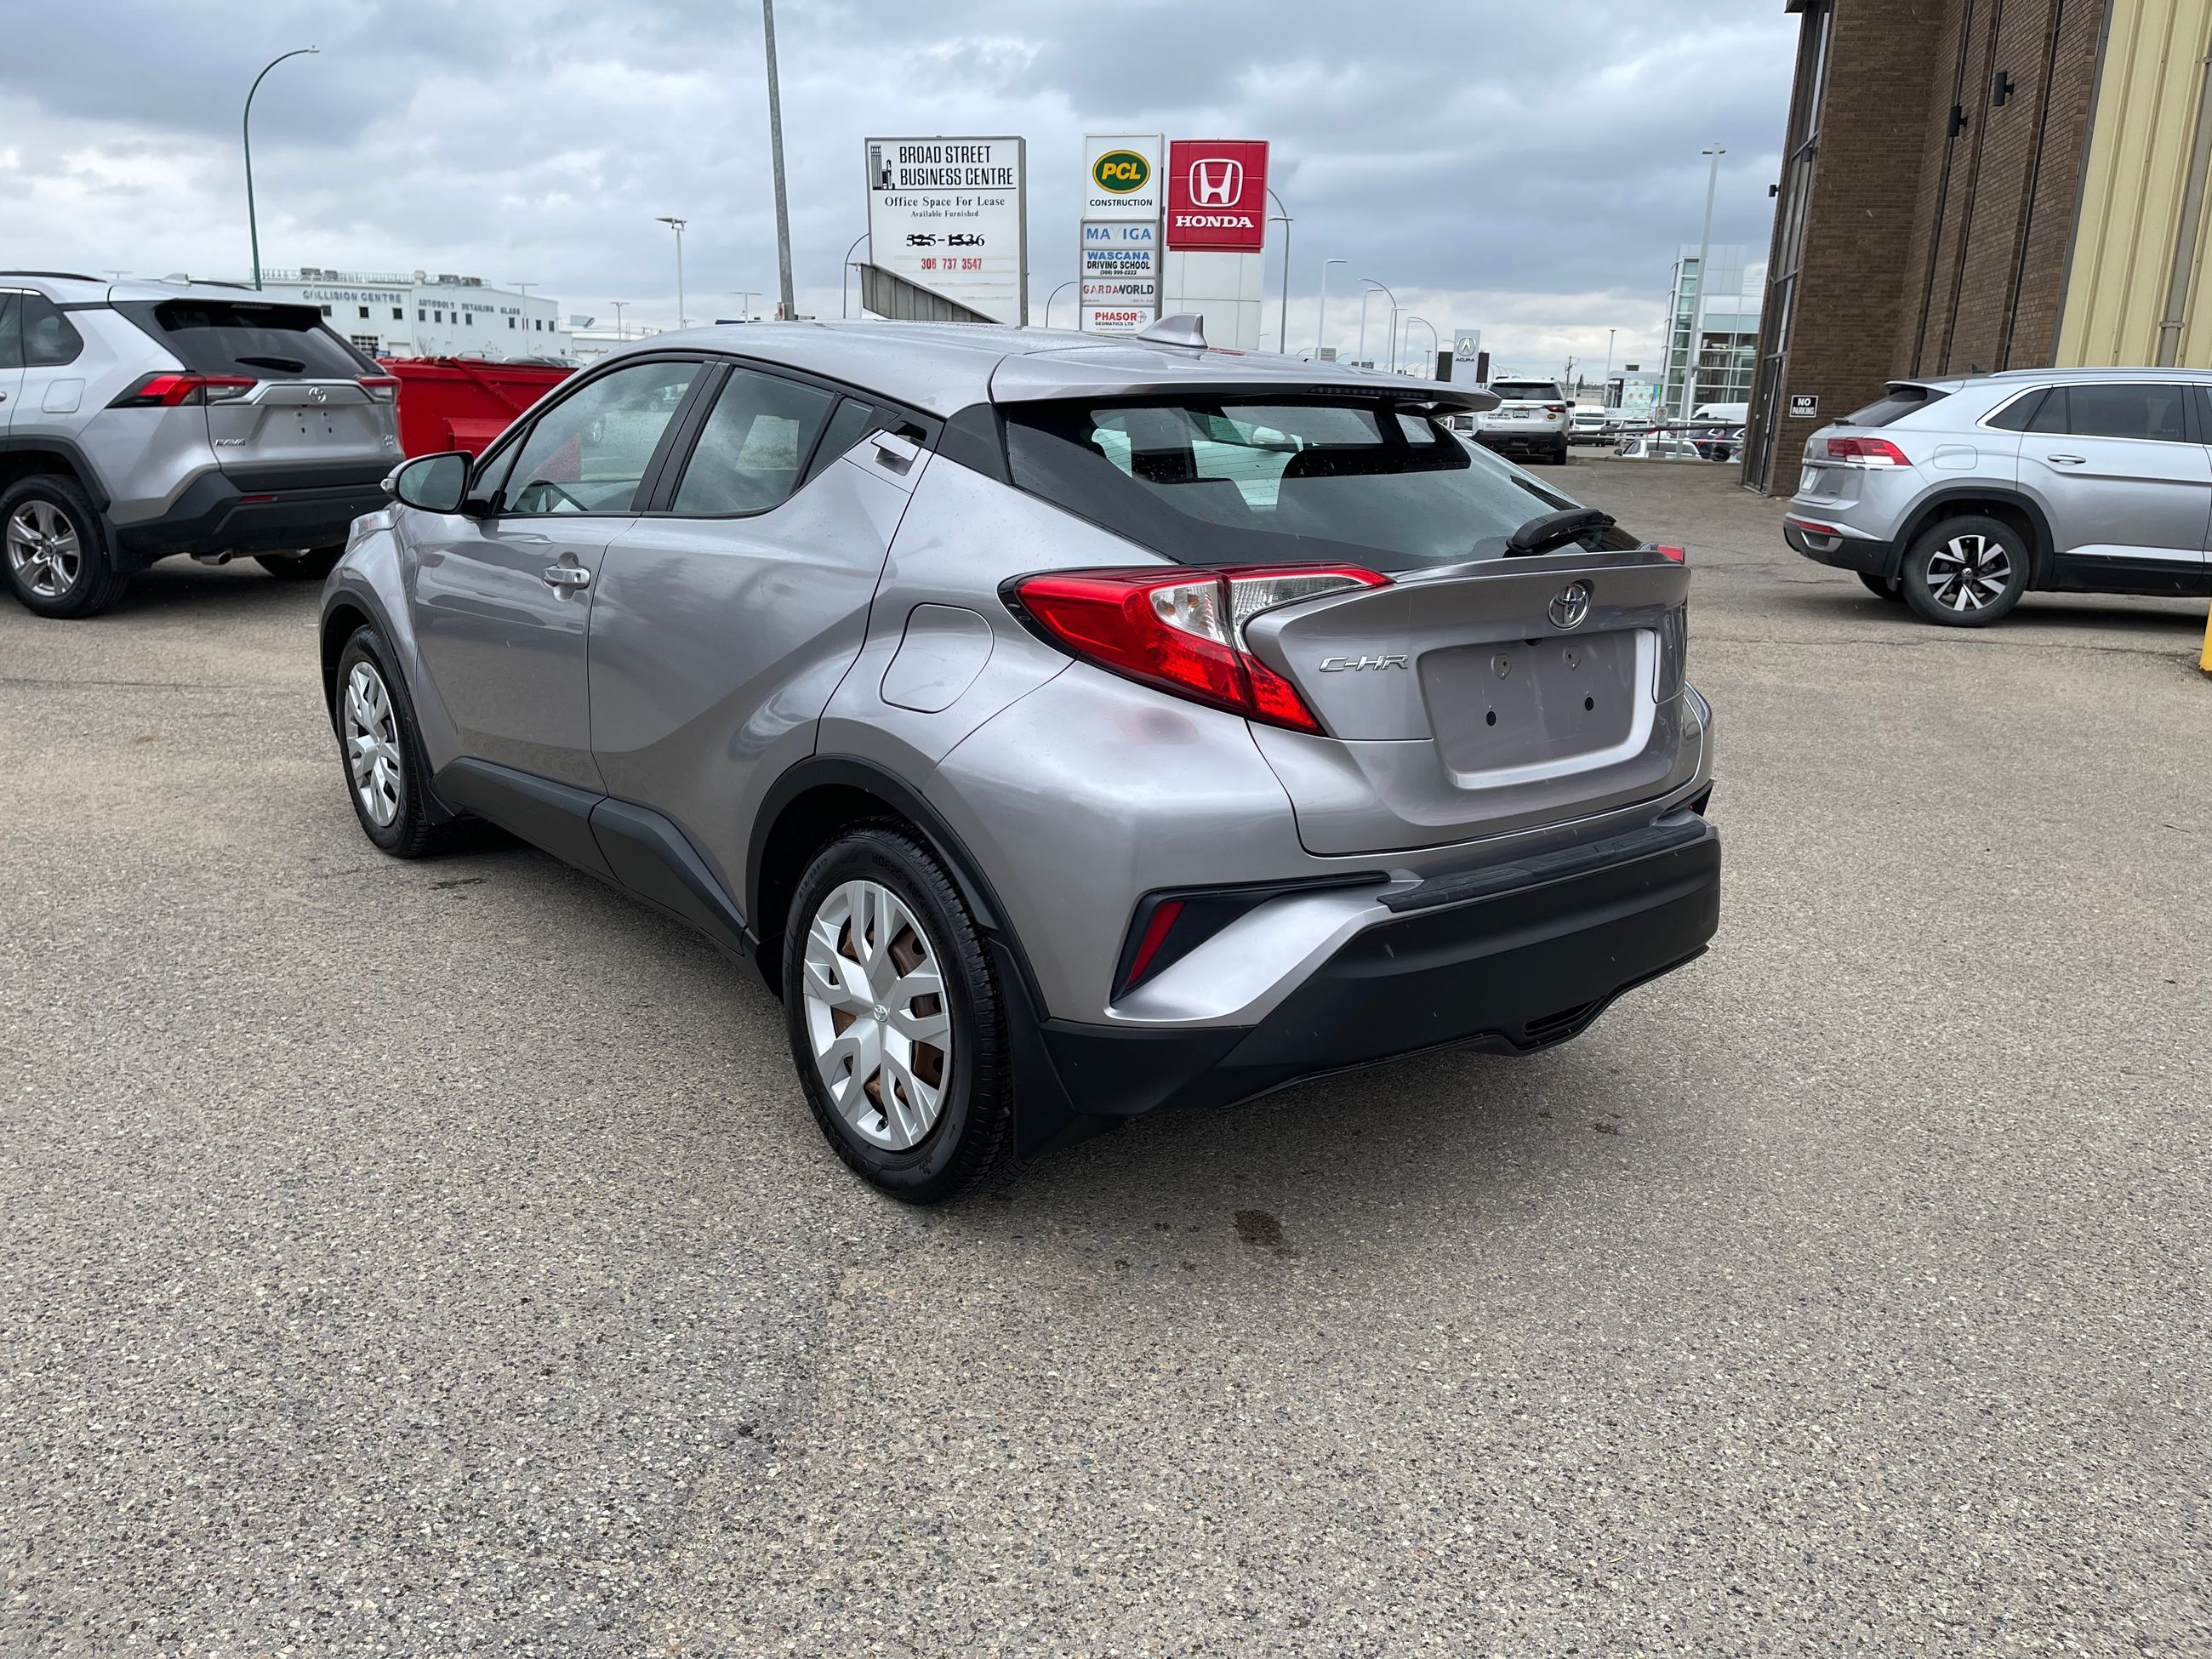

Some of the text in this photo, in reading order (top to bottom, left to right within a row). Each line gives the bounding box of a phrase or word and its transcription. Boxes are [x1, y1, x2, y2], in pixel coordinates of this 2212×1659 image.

[899, 145, 991, 163] BROAD STREET
[900, 168, 1013, 185] BUSINESS CENTRE
[1101, 162, 1142, 180] PCL
[885, 196, 1006, 208] Office Space For Lease
[1089, 198, 1153, 207] CONSTRUCTION
[1175, 215, 1254, 228] HONDA
[1087, 251, 1150, 260] WASCANA
[921, 258, 982, 270] 306 737 3547
[1086, 260, 1150, 270] DRIVING SCHOOL
[1083, 284, 1154, 294] GARDAWORLD
[361, 292, 402, 304] CENTRE
[1095, 311, 1137, 322] PHASOR
[1797, 397, 1811, 407] NO
[1319, 653, 1409, 673] C-HR
